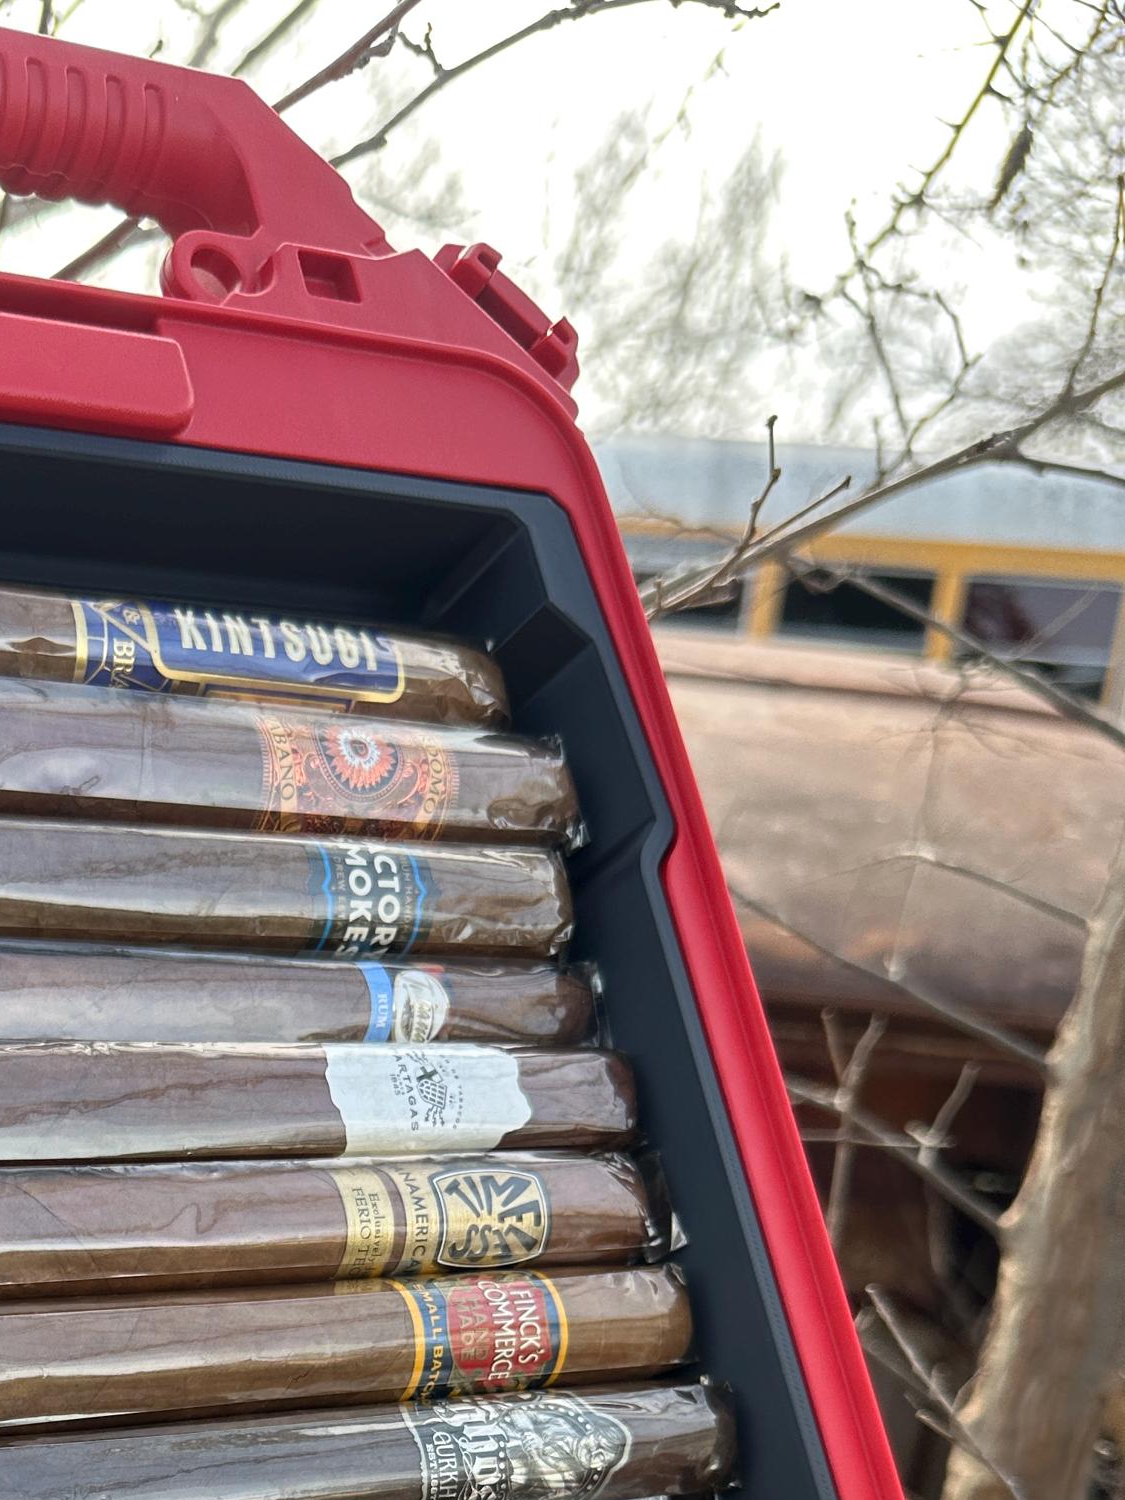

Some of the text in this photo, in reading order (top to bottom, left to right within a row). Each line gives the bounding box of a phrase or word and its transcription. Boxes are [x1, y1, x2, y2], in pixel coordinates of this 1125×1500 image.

[175, 607, 378, 672] KINTSUGI
[270, 721, 295, 801] ABANO
[423, 742, 443, 814] DOMO
[336, 843, 373, 957] MOKES
[362, 840, 401, 957] ACTORY
[376, 993, 388, 1029] RUM
[393, 1054, 419, 1131] ARTAGAS
[351, 1187, 372, 1240] FERIO
[413, 1283, 444, 1400] SMALL BATCH
[456, 1303, 475, 1361] MADE
[468, 1301, 489, 1361] HAND
[477, 1280, 516, 1381] COMMERCE
[510, 1289, 545, 1364] FINCK'S
